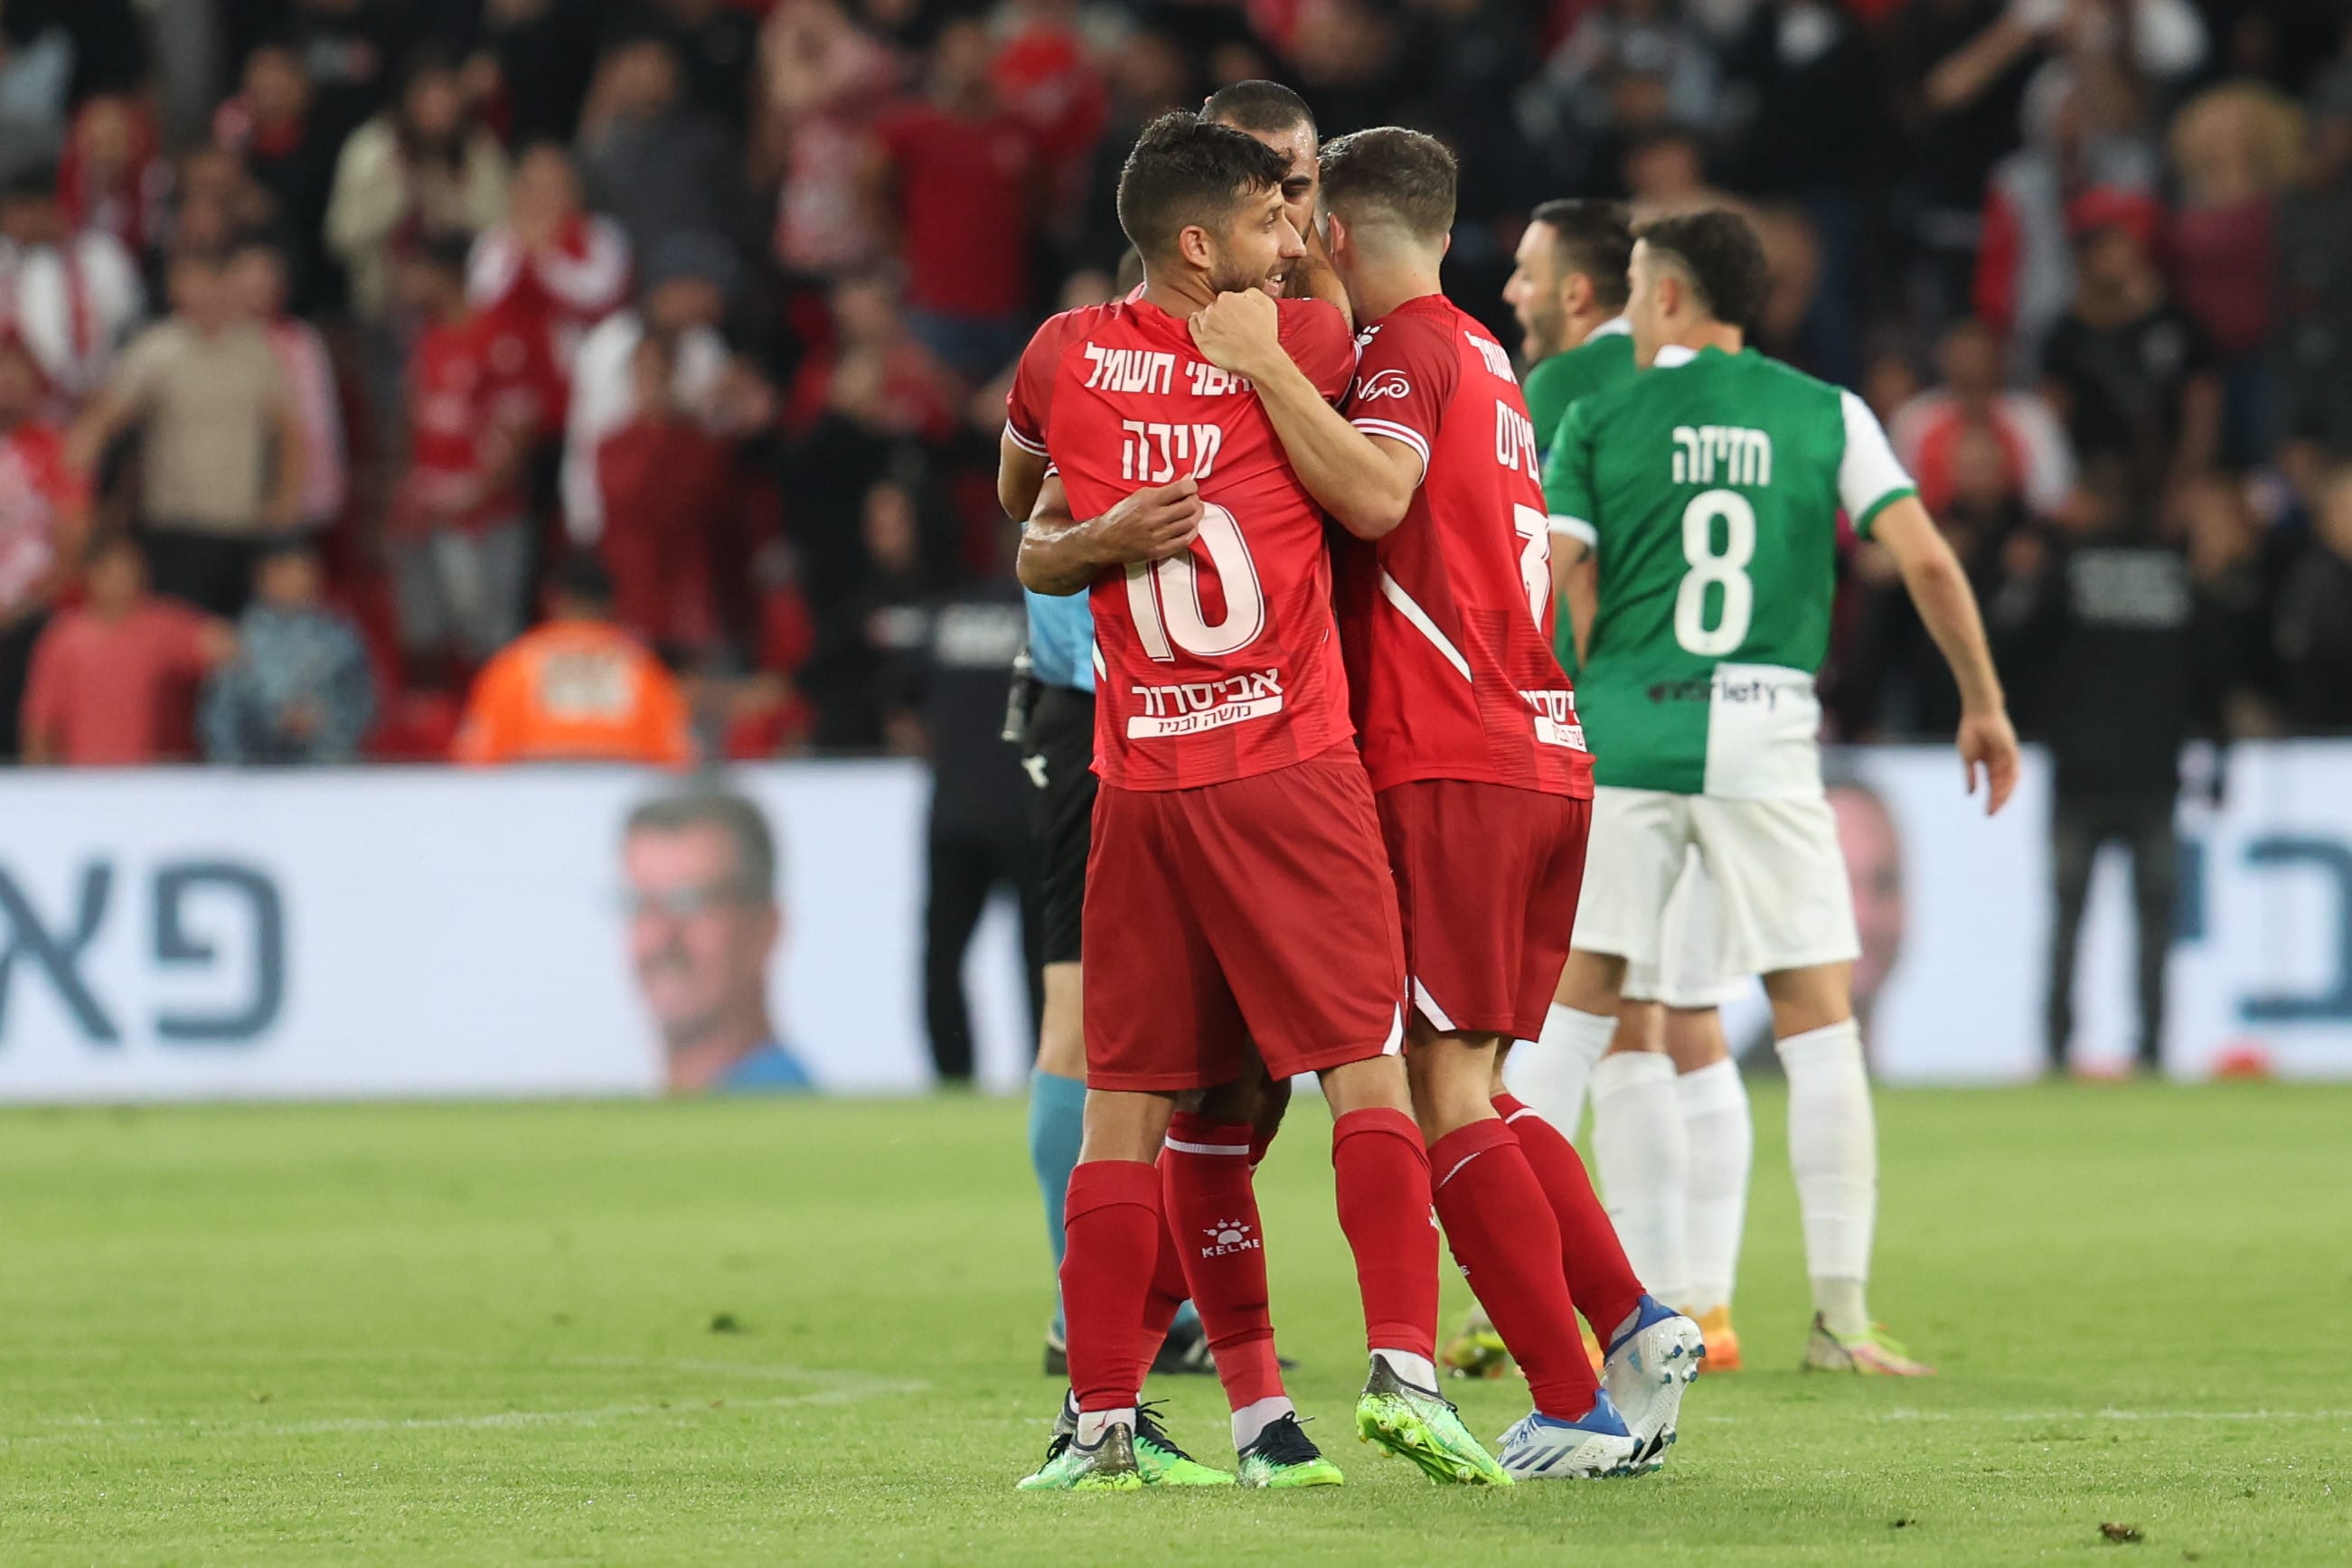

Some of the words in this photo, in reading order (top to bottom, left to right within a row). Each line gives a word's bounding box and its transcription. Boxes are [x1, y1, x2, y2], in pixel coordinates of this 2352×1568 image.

[1084, 340, 1176, 395] חשמל
[1185, 361, 1251, 396] חסני
[1463, 330, 1519, 386] שמל
[1122, 419, 1222, 484] מיכה
[1672, 425, 1772, 486] חזיזה
[1124, 500, 1265, 662] 10
[1674, 489, 1756, 657] 8
[1132, 668, 1284, 717] אביסרור
[1204, 705, 1252, 727] משה
[1159, 716, 1198, 734] ובניו
[1201, 1238, 1261, 1259] KELME
